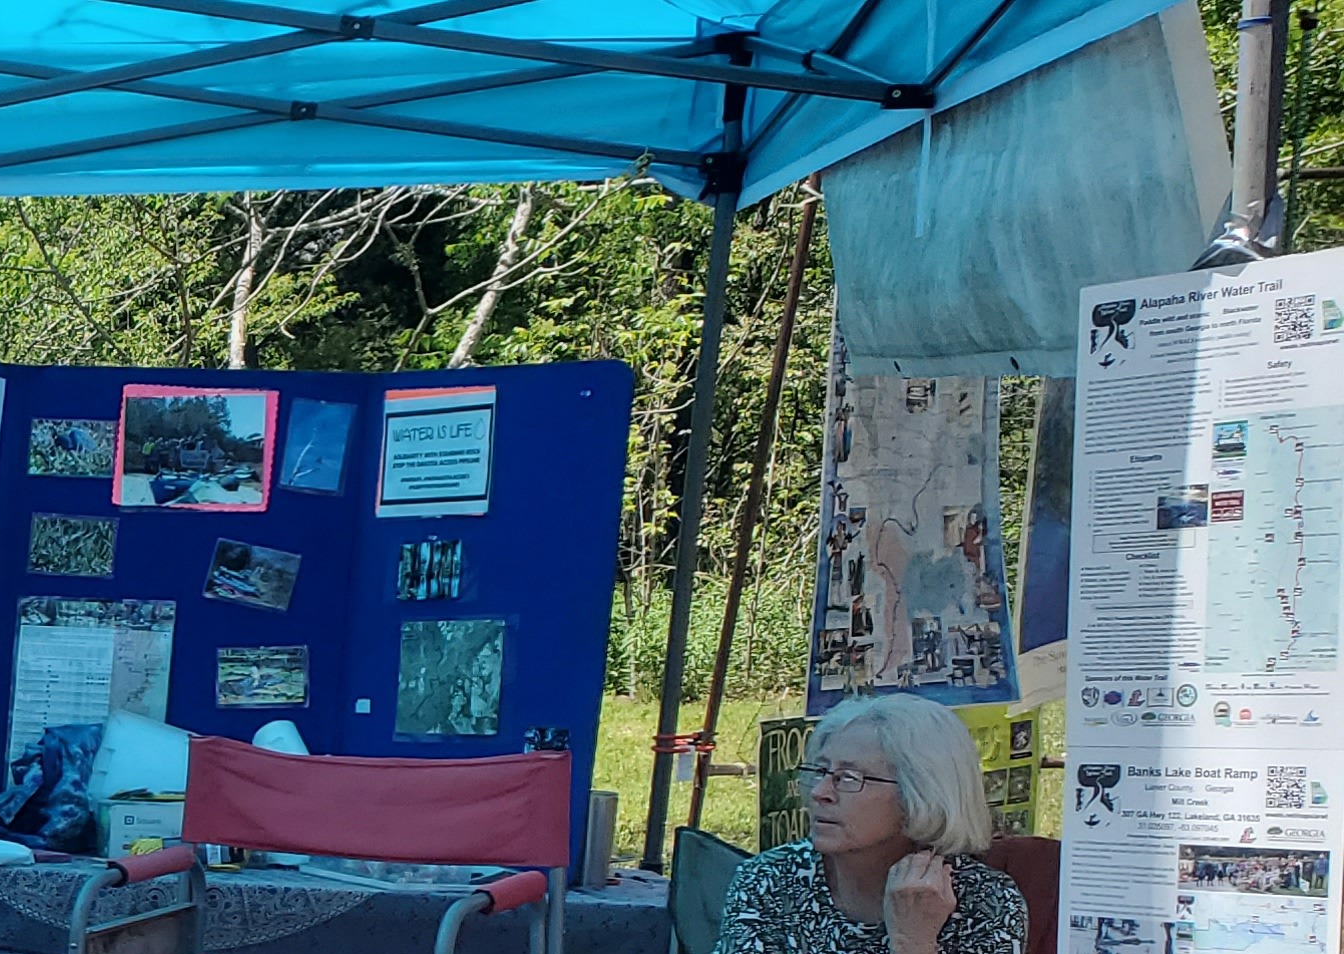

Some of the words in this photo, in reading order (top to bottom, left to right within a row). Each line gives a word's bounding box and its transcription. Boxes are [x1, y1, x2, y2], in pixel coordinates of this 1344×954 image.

[1140, 294, 1186, 309] Alapaha
[1188, 290, 1218, 303] River
[1221, 285, 1255, 298] Water
[1258, 279, 1284, 293] Trail
[1267, 361, 1292, 370] Safety
[392, 426, 434, 442] WATER
[437, 425, 447, 440] IS
[450, 423, 473, 439] LIFE
[1125, 551, 1161, 561] Checklist
[1158, 713, 1195, 722] GEORGIA
[1127, 766, 1162, 777] Banks
[1165, 766, 1192, 778] Lake
[1194, 767, 1222, 779] Boat
[1224, 768, 1258, 782] Ramp
[1186, 798, 1209, 806] Creek
[1136, 810, 1148, 818] GA
[1149, 811, 1165, 821] Hwy
[1223, 814, 1236, 822] GA
[1285, 828, 1326, 838] GEORGIA
